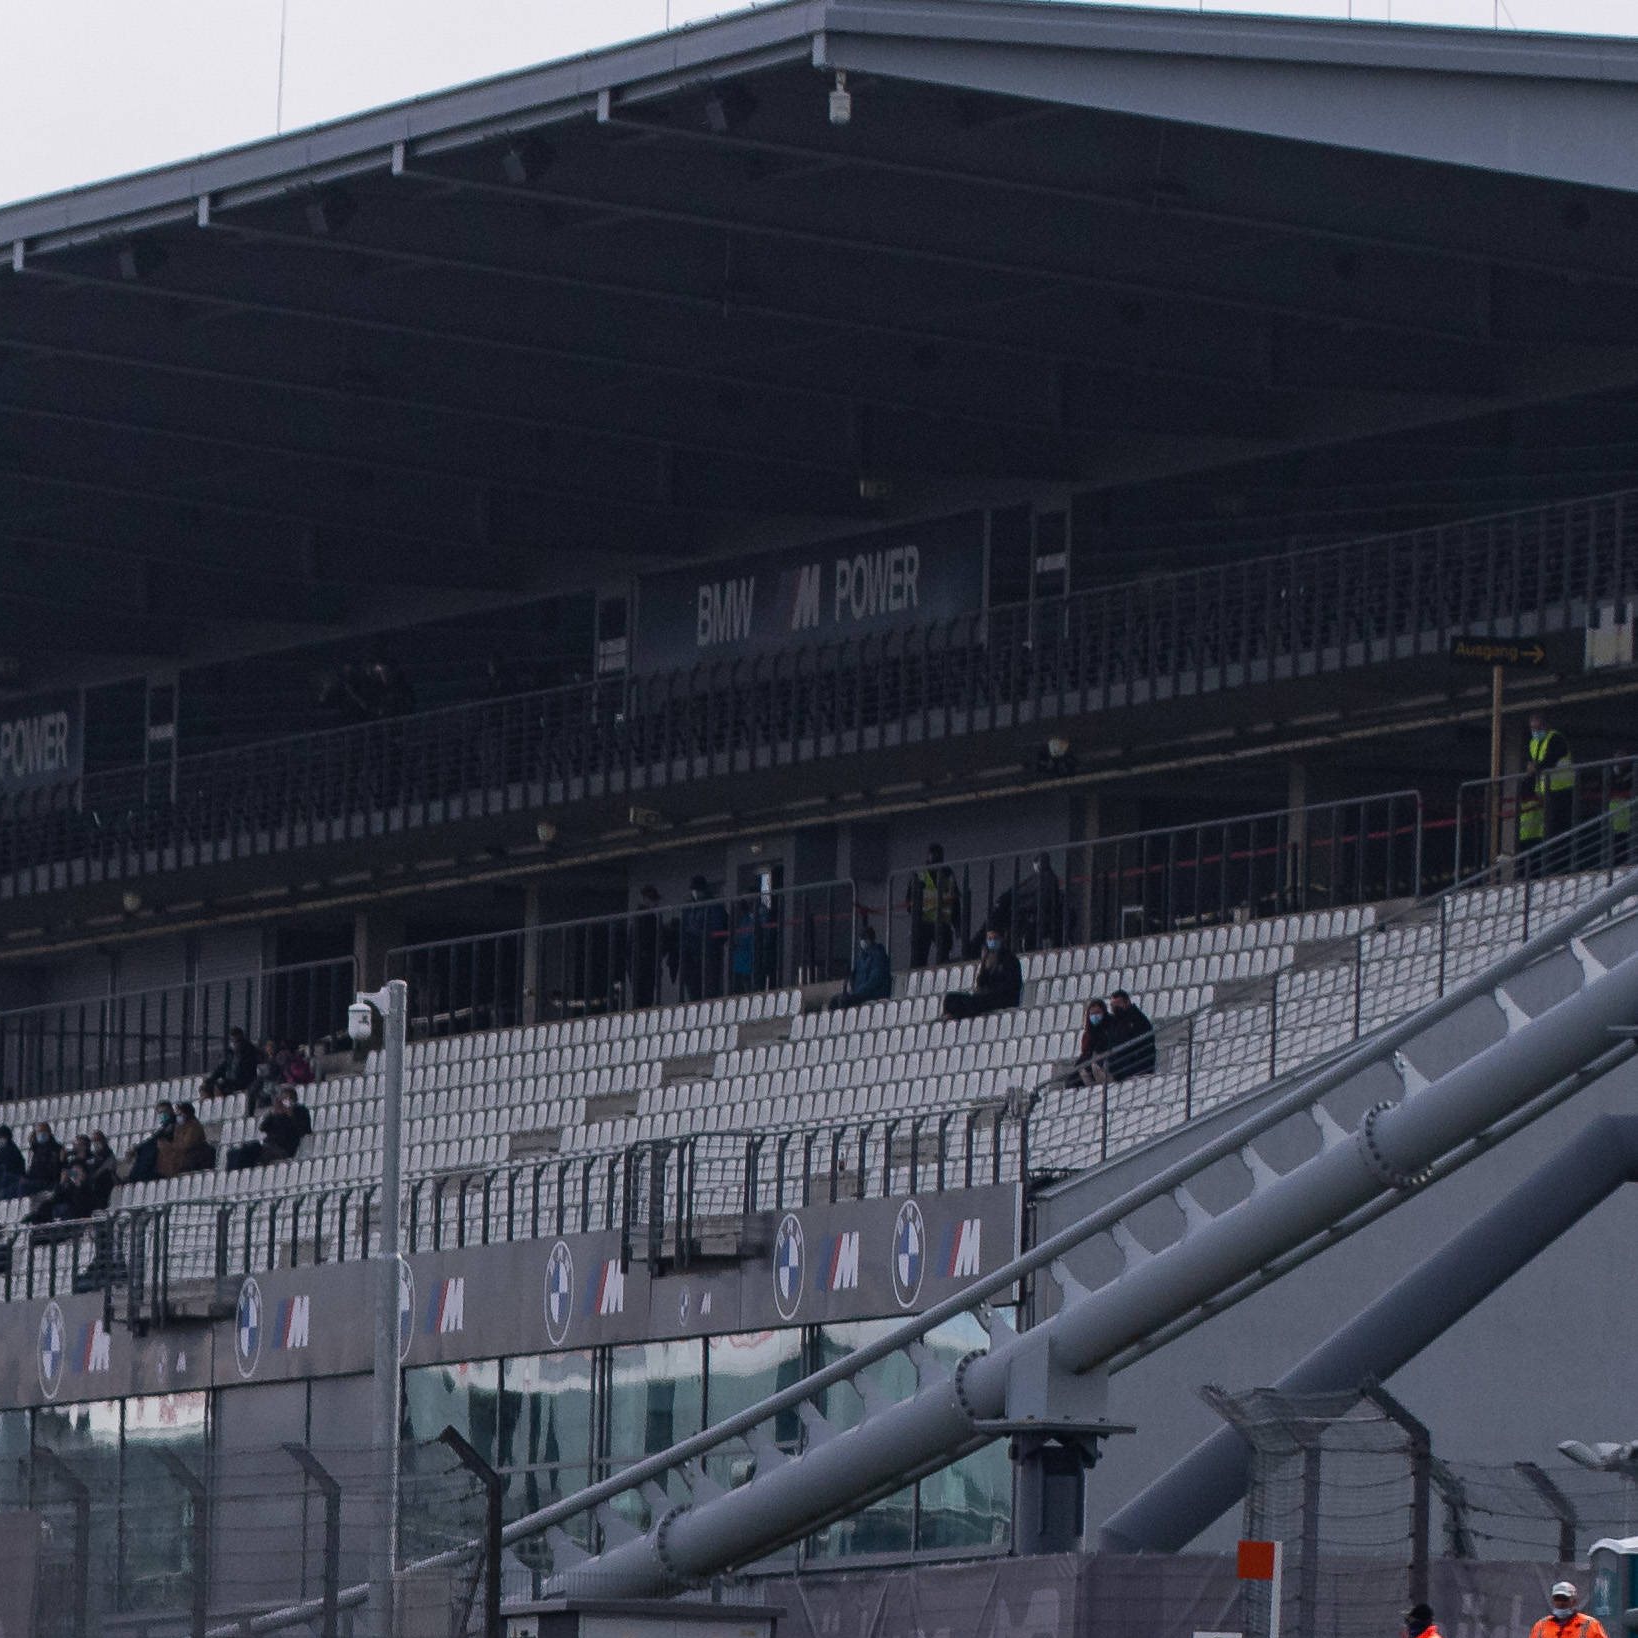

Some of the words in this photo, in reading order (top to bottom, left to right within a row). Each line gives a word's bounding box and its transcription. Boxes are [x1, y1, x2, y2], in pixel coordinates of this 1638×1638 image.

[697, 577, 754, 646] BMW
[836, 546, 919, 621] POWER
[1455, 642, 1518, 662] Ausgang
